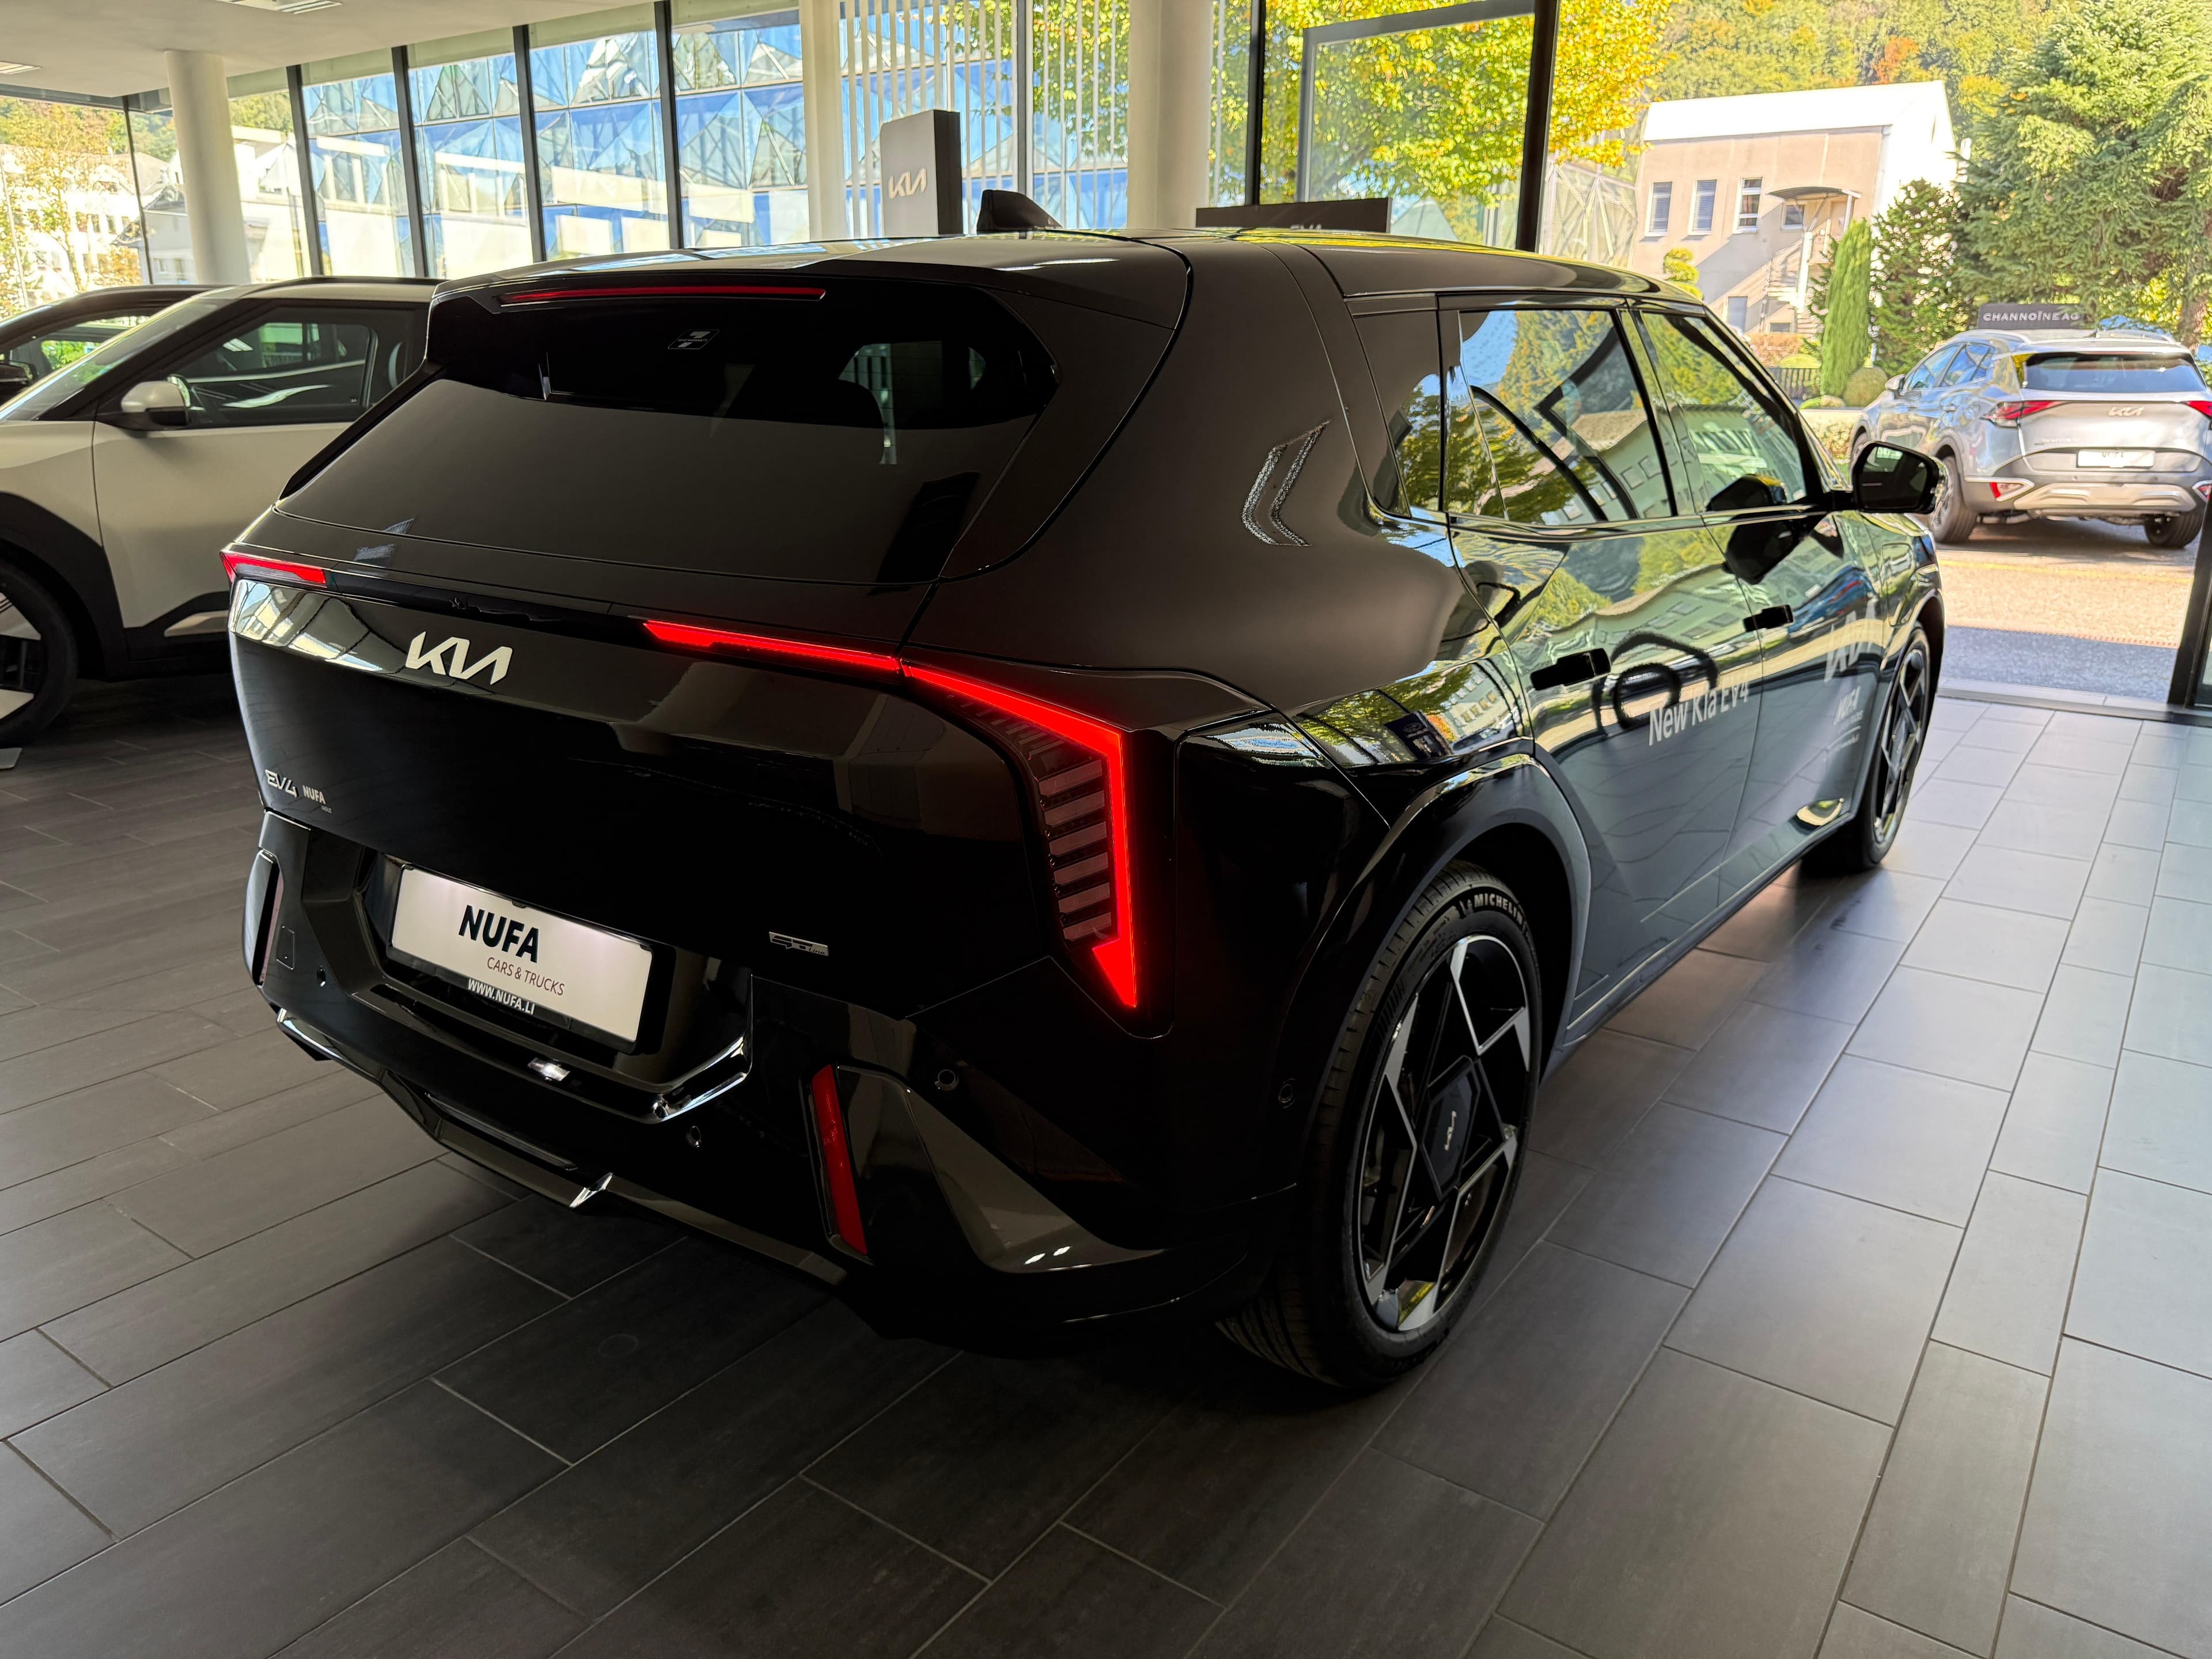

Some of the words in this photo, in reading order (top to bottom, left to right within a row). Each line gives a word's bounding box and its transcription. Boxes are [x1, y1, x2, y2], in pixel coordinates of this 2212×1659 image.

[888, 167, 927, 199] KIA
[406, 631, 513, 685] KIA
[1649, 702, 1688, 747] New
[265, 769, 298, 798] EV4
[302, 785, 326, 804] NUFA
[1474, 893, 1524, 925] MICHELIN
[459, 904, 539, 963] NUFA
[487, 957, 514, 976] CARS
[515, 967, 521, 979] &
[524, 970, 565, 995] TRUCKS
[468, 979, 535, 1015] WWW.NUFA.LI
